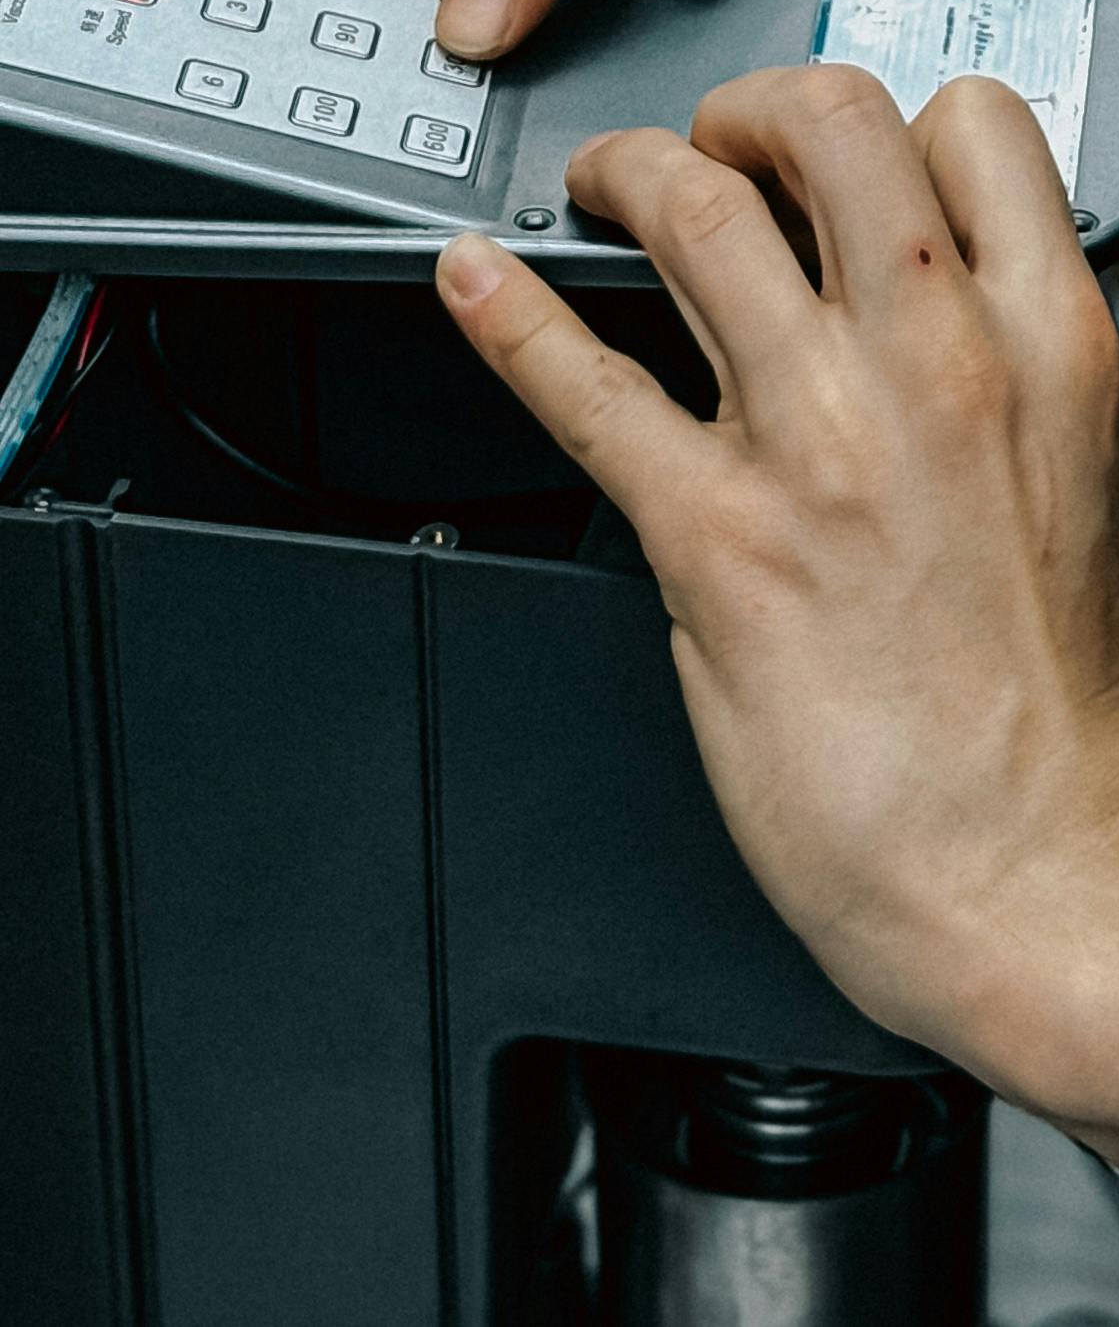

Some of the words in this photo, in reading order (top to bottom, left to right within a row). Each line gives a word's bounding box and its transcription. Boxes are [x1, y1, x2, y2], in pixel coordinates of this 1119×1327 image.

[226, 0, 249, 13] 3
[105, 8, 133, 46] Speed
[334, 23, 360, 44] 90
[442, 54, 467, 75] 30
[202, 73, 225, 88] 6
[313, 96, 338, 123] 100
[423, 122, 449, 153] 600
